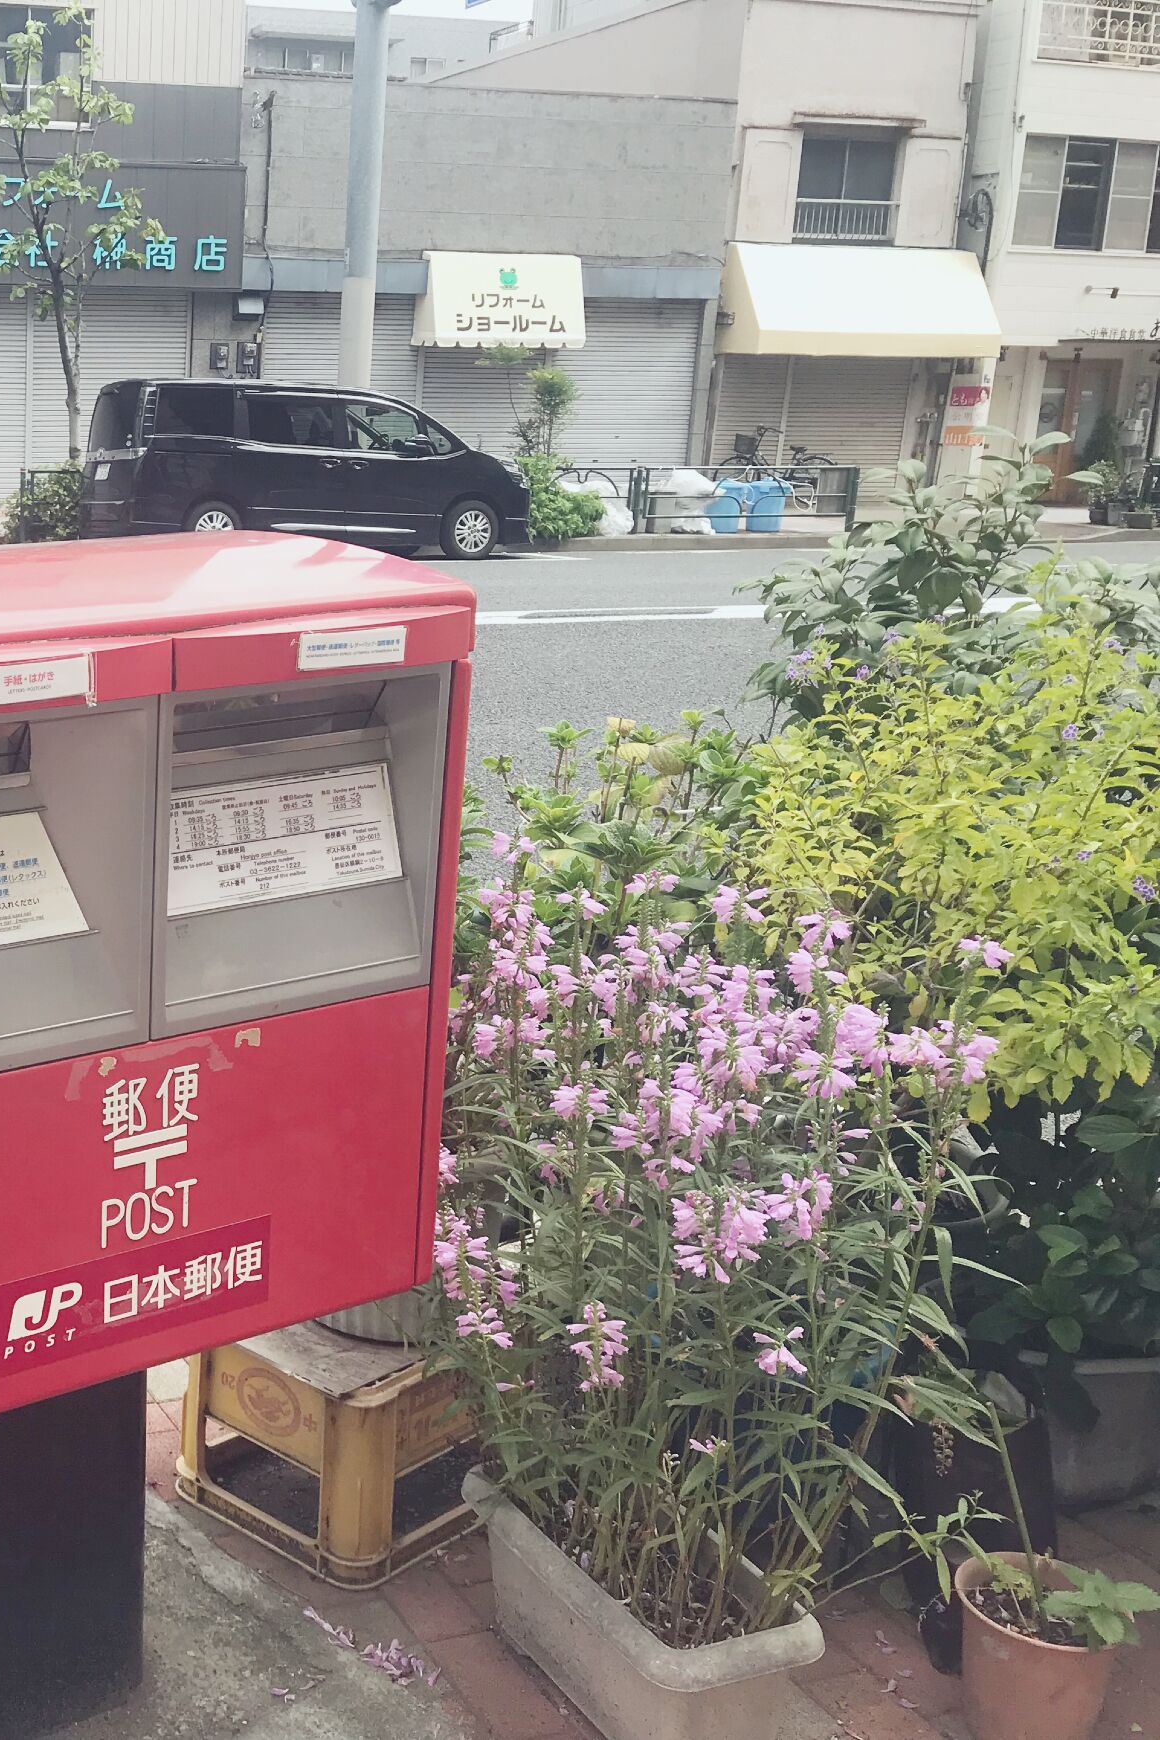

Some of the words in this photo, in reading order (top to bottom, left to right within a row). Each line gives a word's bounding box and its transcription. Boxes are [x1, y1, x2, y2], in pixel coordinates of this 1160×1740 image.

[471, 293, 545, 309] リフォーム
[456, 313, 566, 333] ショールーム
[3, 671, 55, 687] 手紙・はがき
[102, 1063, 199, 1141] 郵便
[101, 1178, 198, 1248] POST
[103, 1240, 263, 1324] 日本郵便
[3, 1328, 77, 1360] POST
